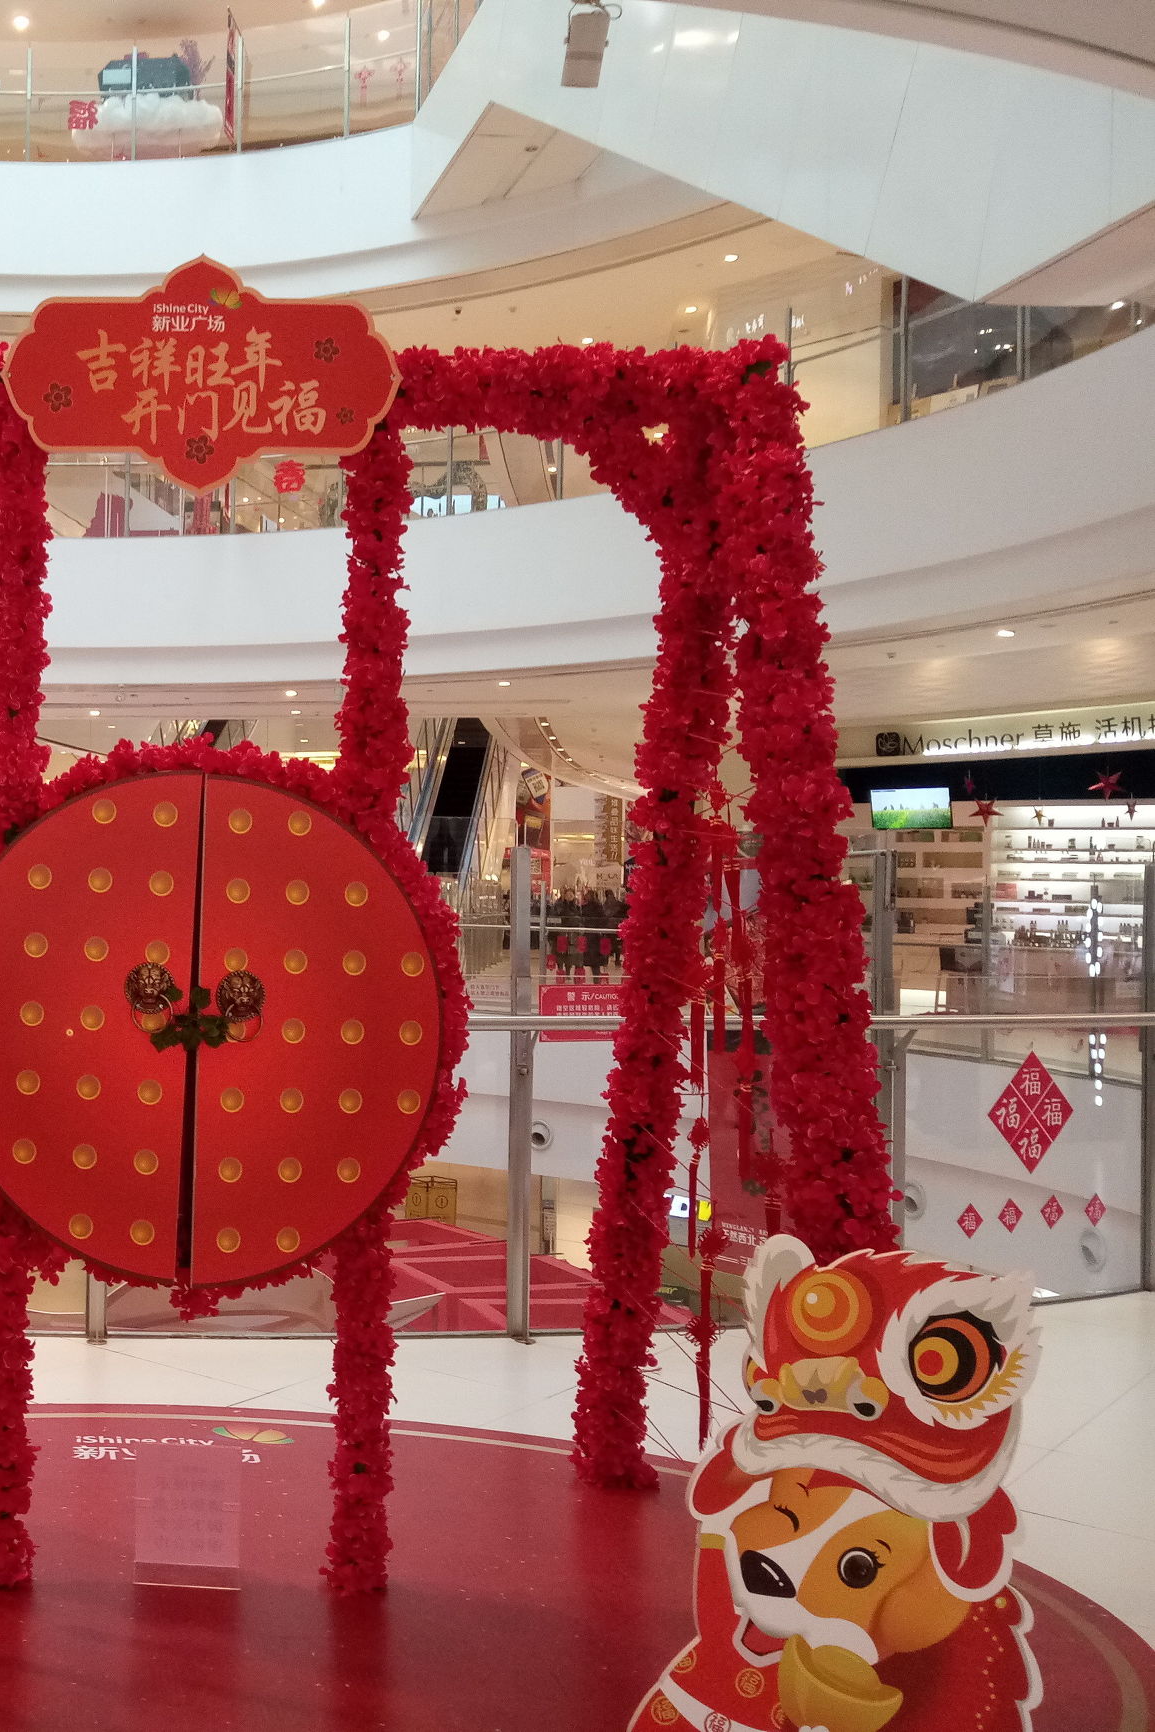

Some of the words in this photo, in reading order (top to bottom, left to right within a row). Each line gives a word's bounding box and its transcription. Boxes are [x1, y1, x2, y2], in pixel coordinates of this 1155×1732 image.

[152, 303, 186, 314] iShine
[187, 303, 210, 315] City
[151, 315, 226, 332] 新业广场
[76, 326, 283, 395] 吉祥旺年
[121, 379, 328, 445] 开门见福
[903, 729, 1025, 756] Moschner
[1019, 1067, 1042, 1097] 福
[995, 1096, 1021, 1131] 福
[1041, 1098, 1063, 1127] 福
[1017, 1127, 1042, 1161] 福
[963, 1211, 977, 1231] 福
[1003, 1207, 1018, 1225] 福
[1044, 1201, 1059, 1222] 福
[160, 1437, 216, 1446] City
